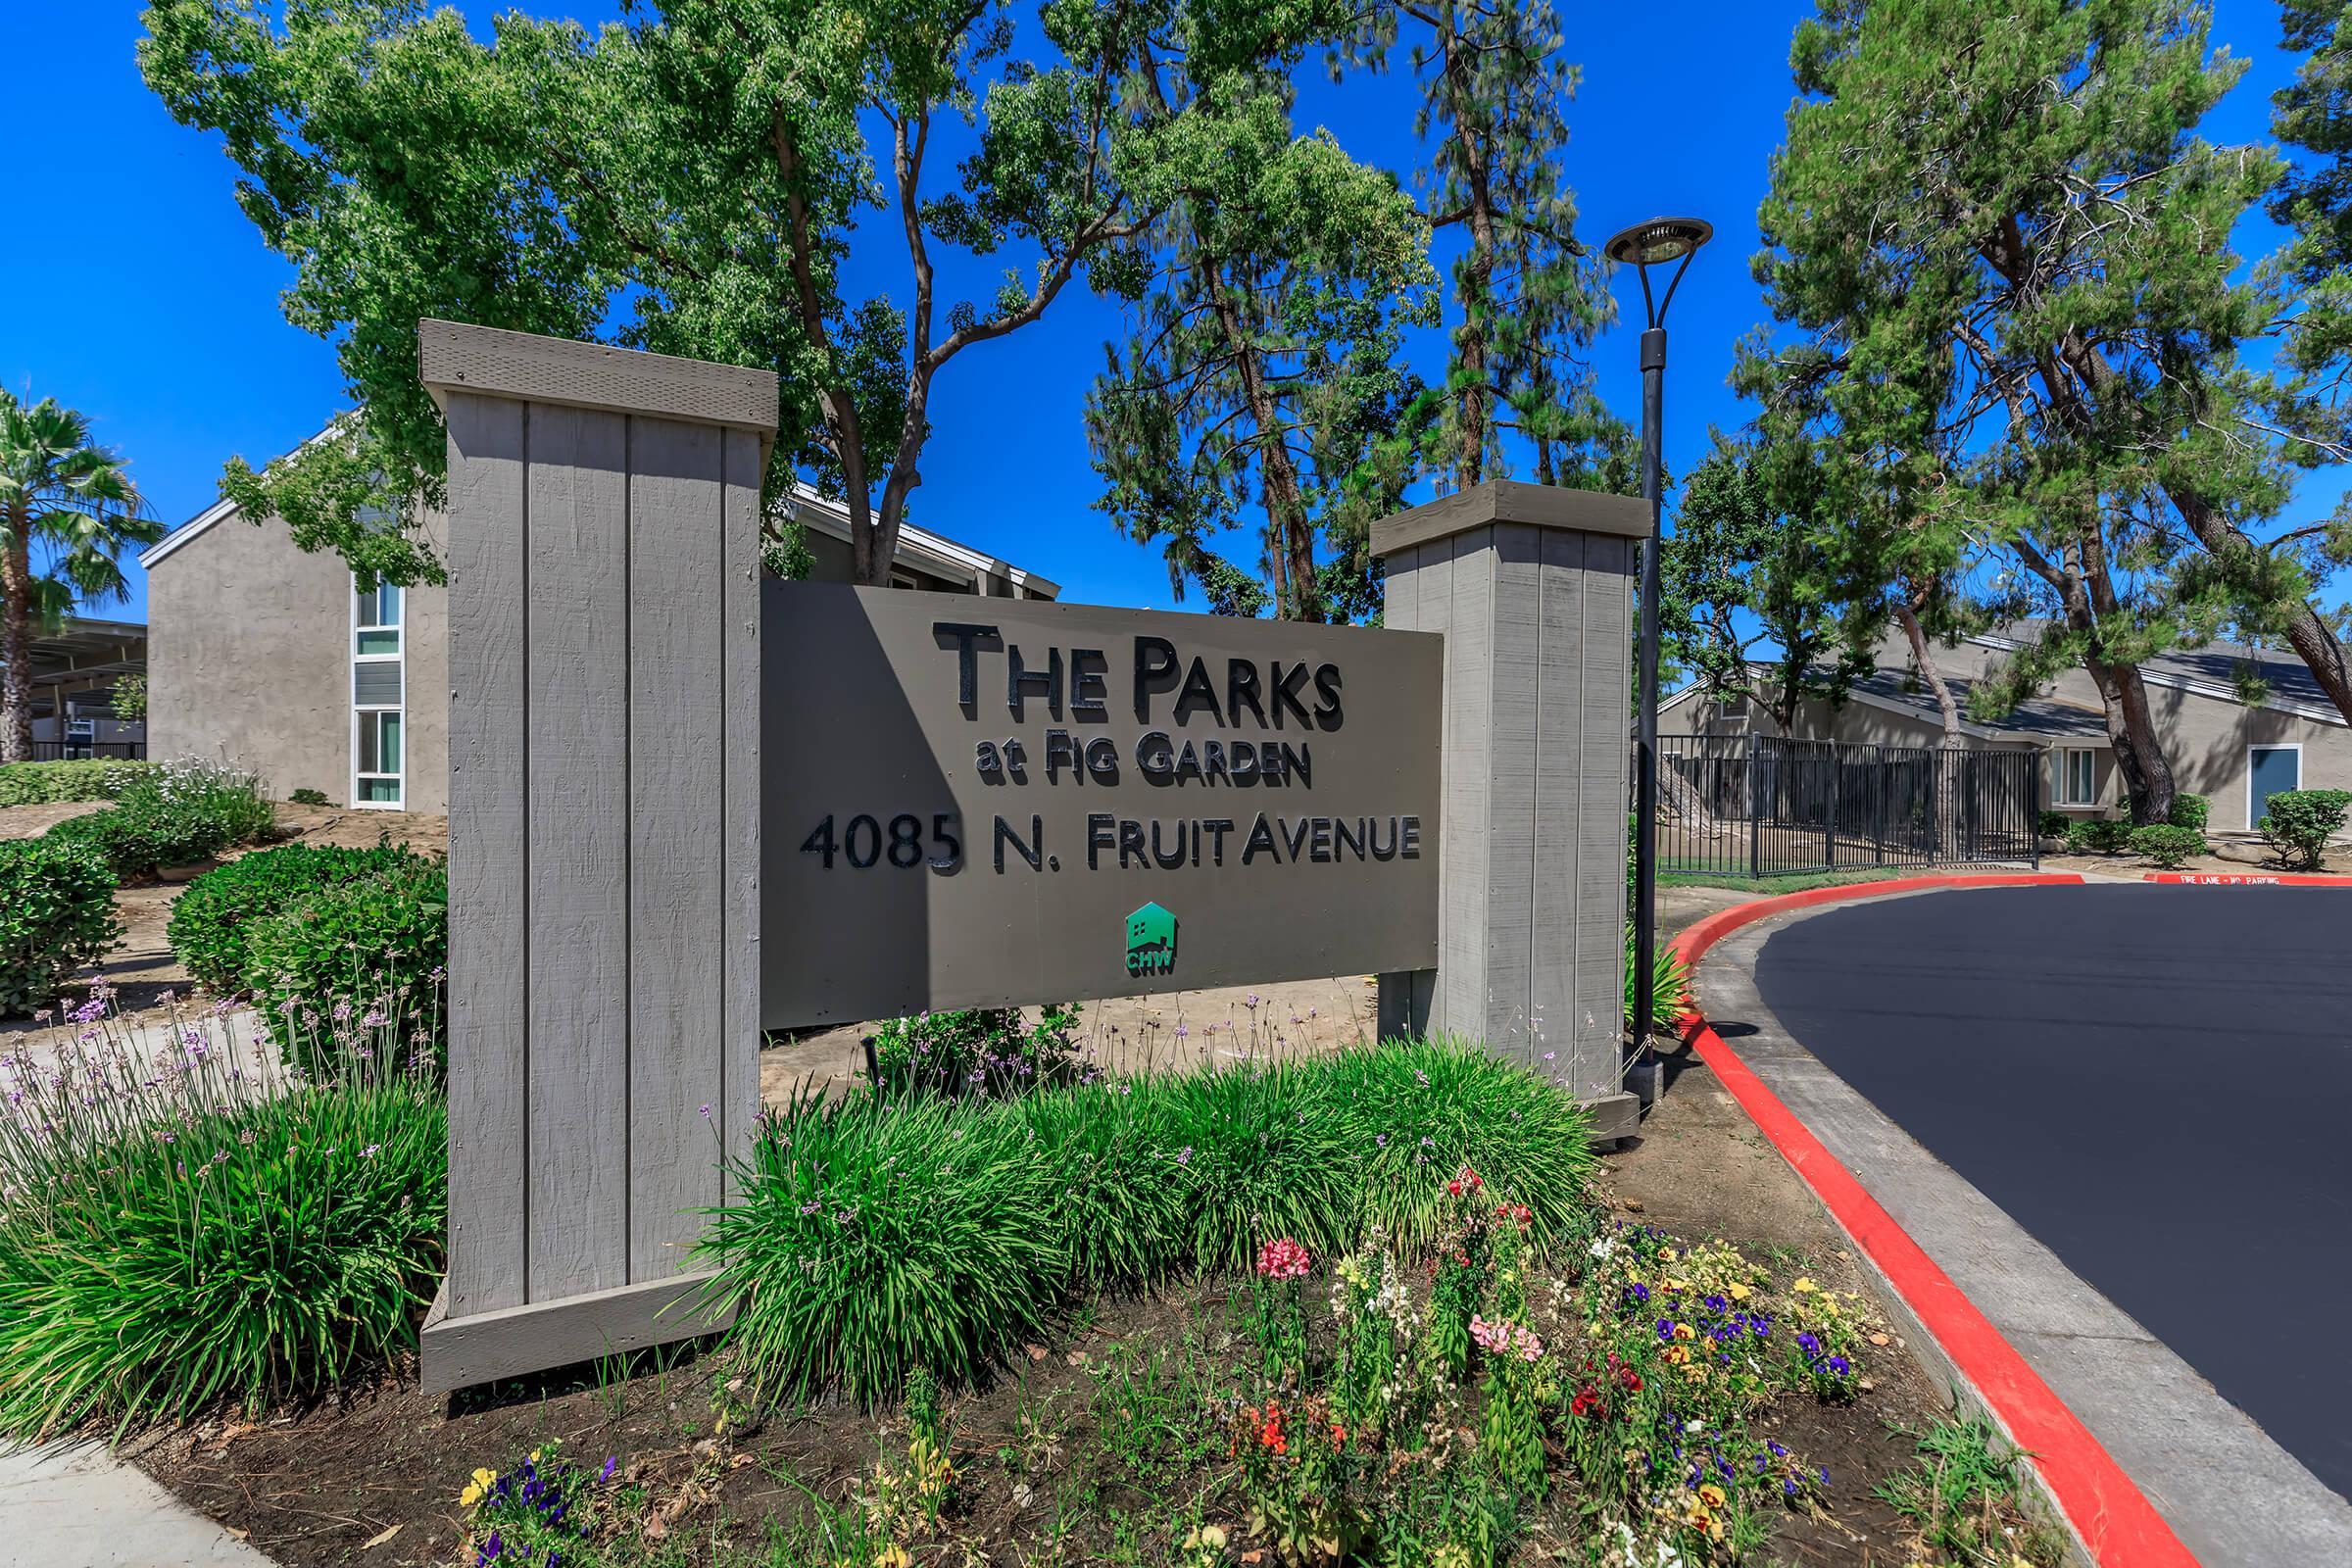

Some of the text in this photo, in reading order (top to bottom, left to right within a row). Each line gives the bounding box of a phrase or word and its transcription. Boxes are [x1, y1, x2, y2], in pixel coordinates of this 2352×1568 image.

[933, 622, 1343, 719] THE PARKS
[976, 729, 1310, 775] at FIG GARDEN
[800, 811, 1420, 872] 4085 N. FRUIT AVENUE
[2180, 875, 2196, 884] FIRE
[2200, 876, 2221, 885] LANE
[2245, 876, 2279, 885] PARKING
[1126, 951, 1173, 969] CHW
